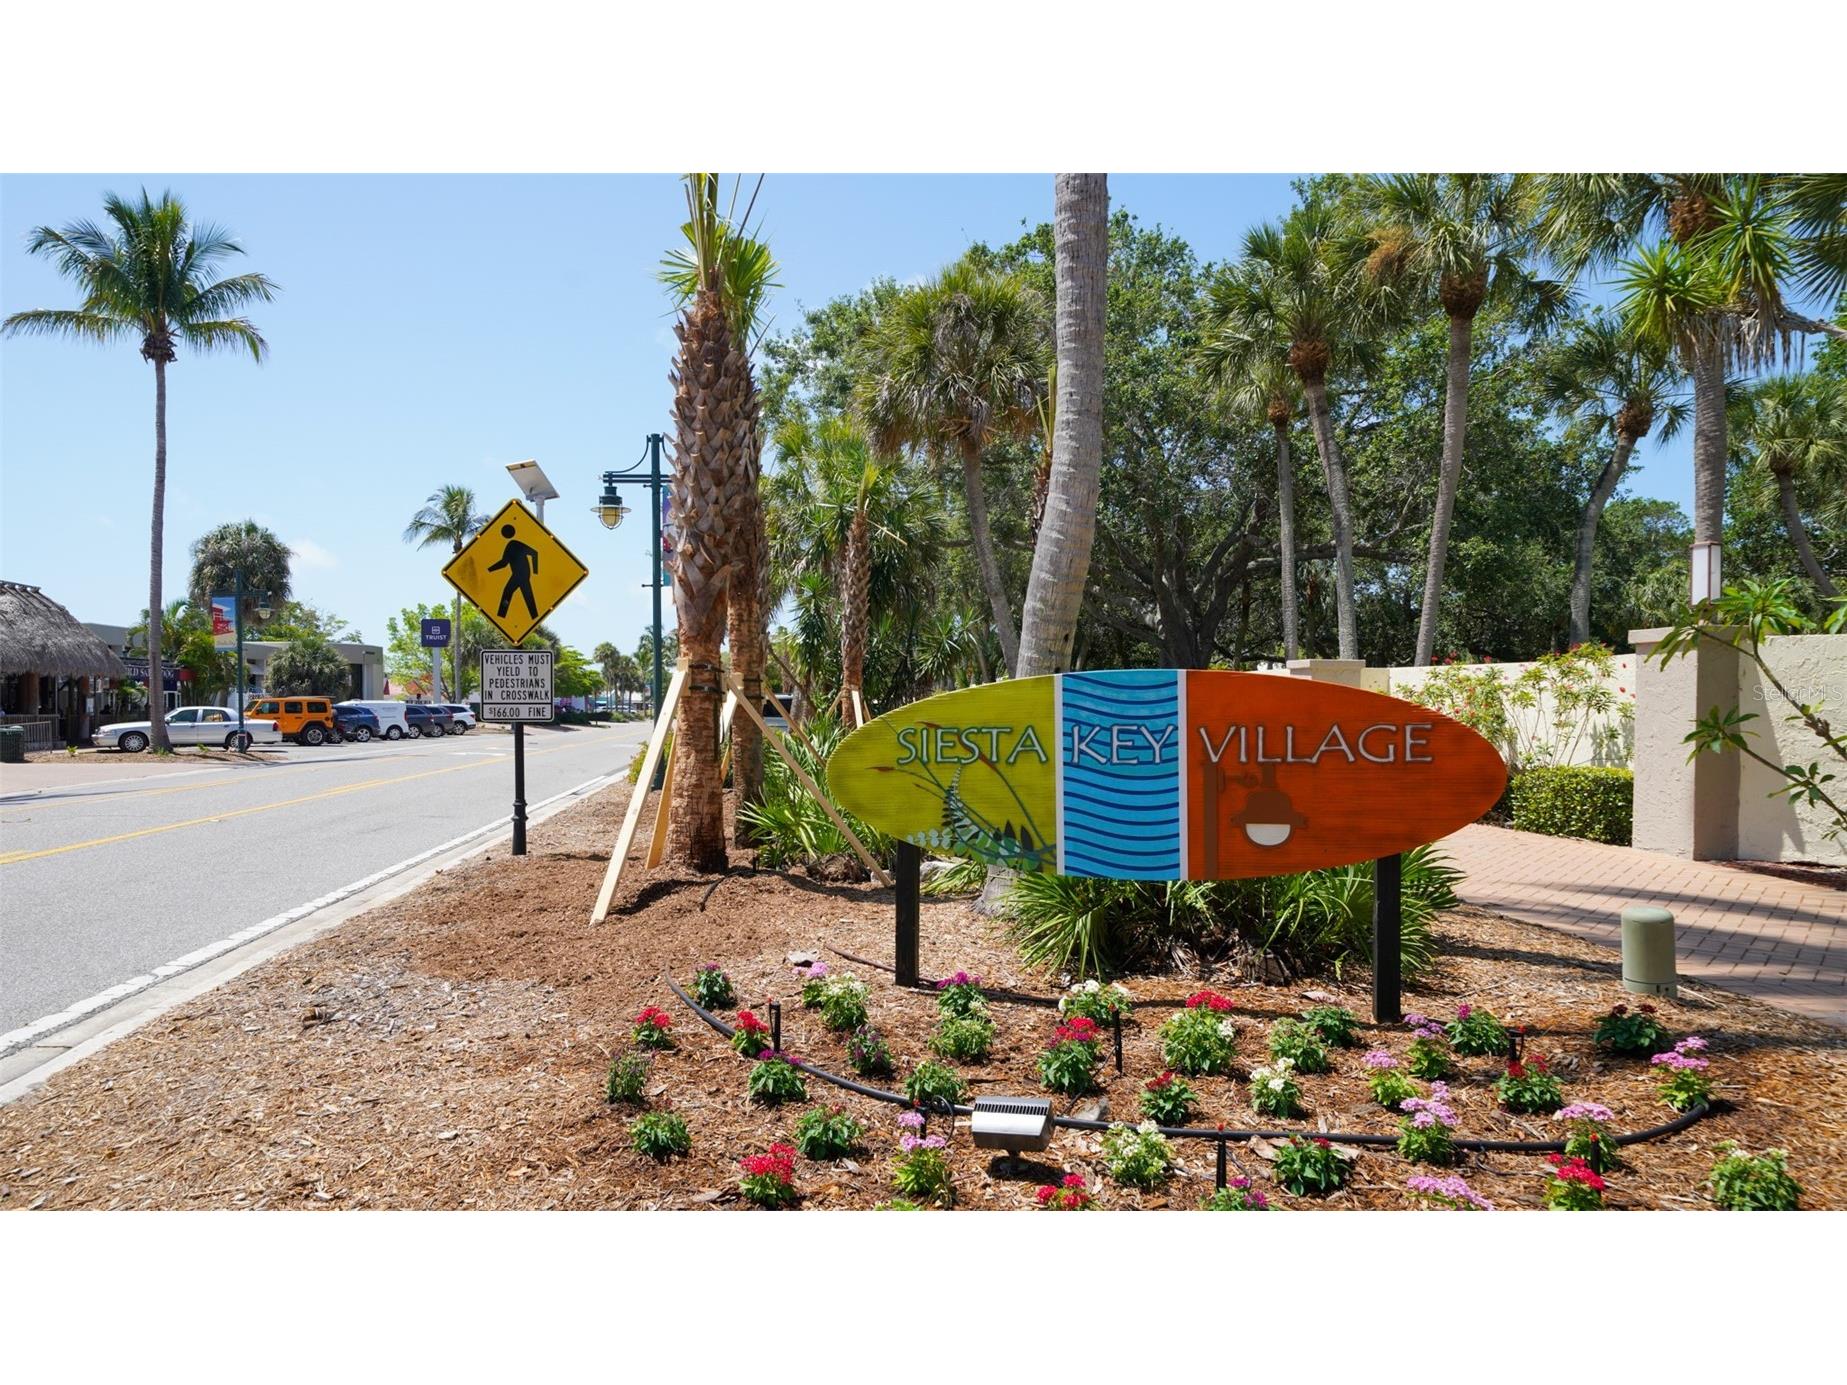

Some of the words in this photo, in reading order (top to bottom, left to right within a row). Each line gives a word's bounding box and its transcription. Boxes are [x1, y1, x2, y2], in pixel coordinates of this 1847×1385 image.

[484, 654, 524, 665] VEHICLES
[528, 654, 550, 665] MUST
[496, 666, 521, 677] YIELD
[528, 666, 539, 677] TO
[489, 678, 546, 689] PEDESTRIANS
[484, 690, 493, 700] IN
[500, 690, 550, 701] CROSSWALK
[488, 707, 521, 718] $166.00
[528, 707, 546, 717] FINE
[897, 725, 1048, 765] SIESTA
[1071, 723, 1175, 764] KEY
[1198, 723, 1433, 764] VILLAGE
